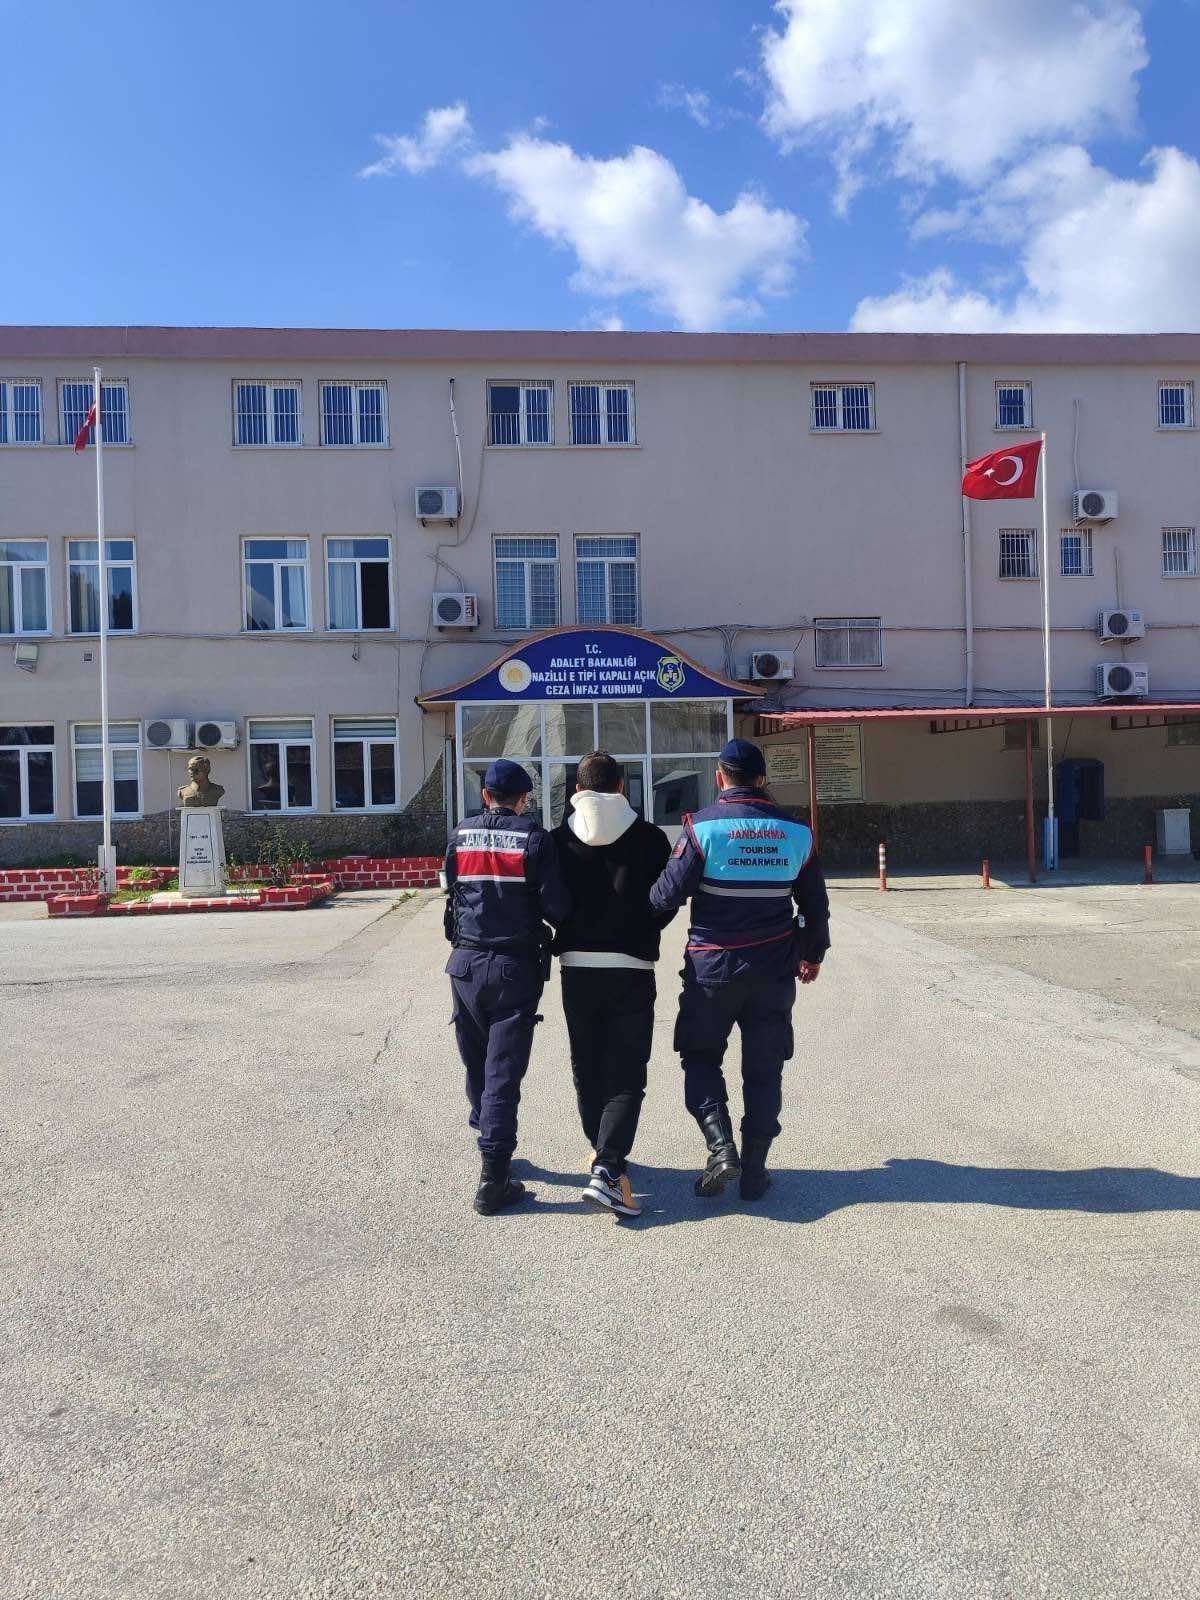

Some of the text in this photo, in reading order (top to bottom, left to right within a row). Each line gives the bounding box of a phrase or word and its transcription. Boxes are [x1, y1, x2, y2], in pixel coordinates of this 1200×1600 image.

[584, 644, 602, 654] T.C.
[550, 656, 637, 668] ADALET BAKANLIĞI
[532, 670, 656, 683] NAZİLLİ E TİPİ KAPALI AÇIK
[545, 683, 643, 695] CEZA İNFAZ KURUMU
[729, 829, 787, 840] JANDARMA
[462, 832, 518, 849] JANDARMA
[739, 846, 779, 854] TOURISM
[727, 858, 789, 866] GENDARMERIE
